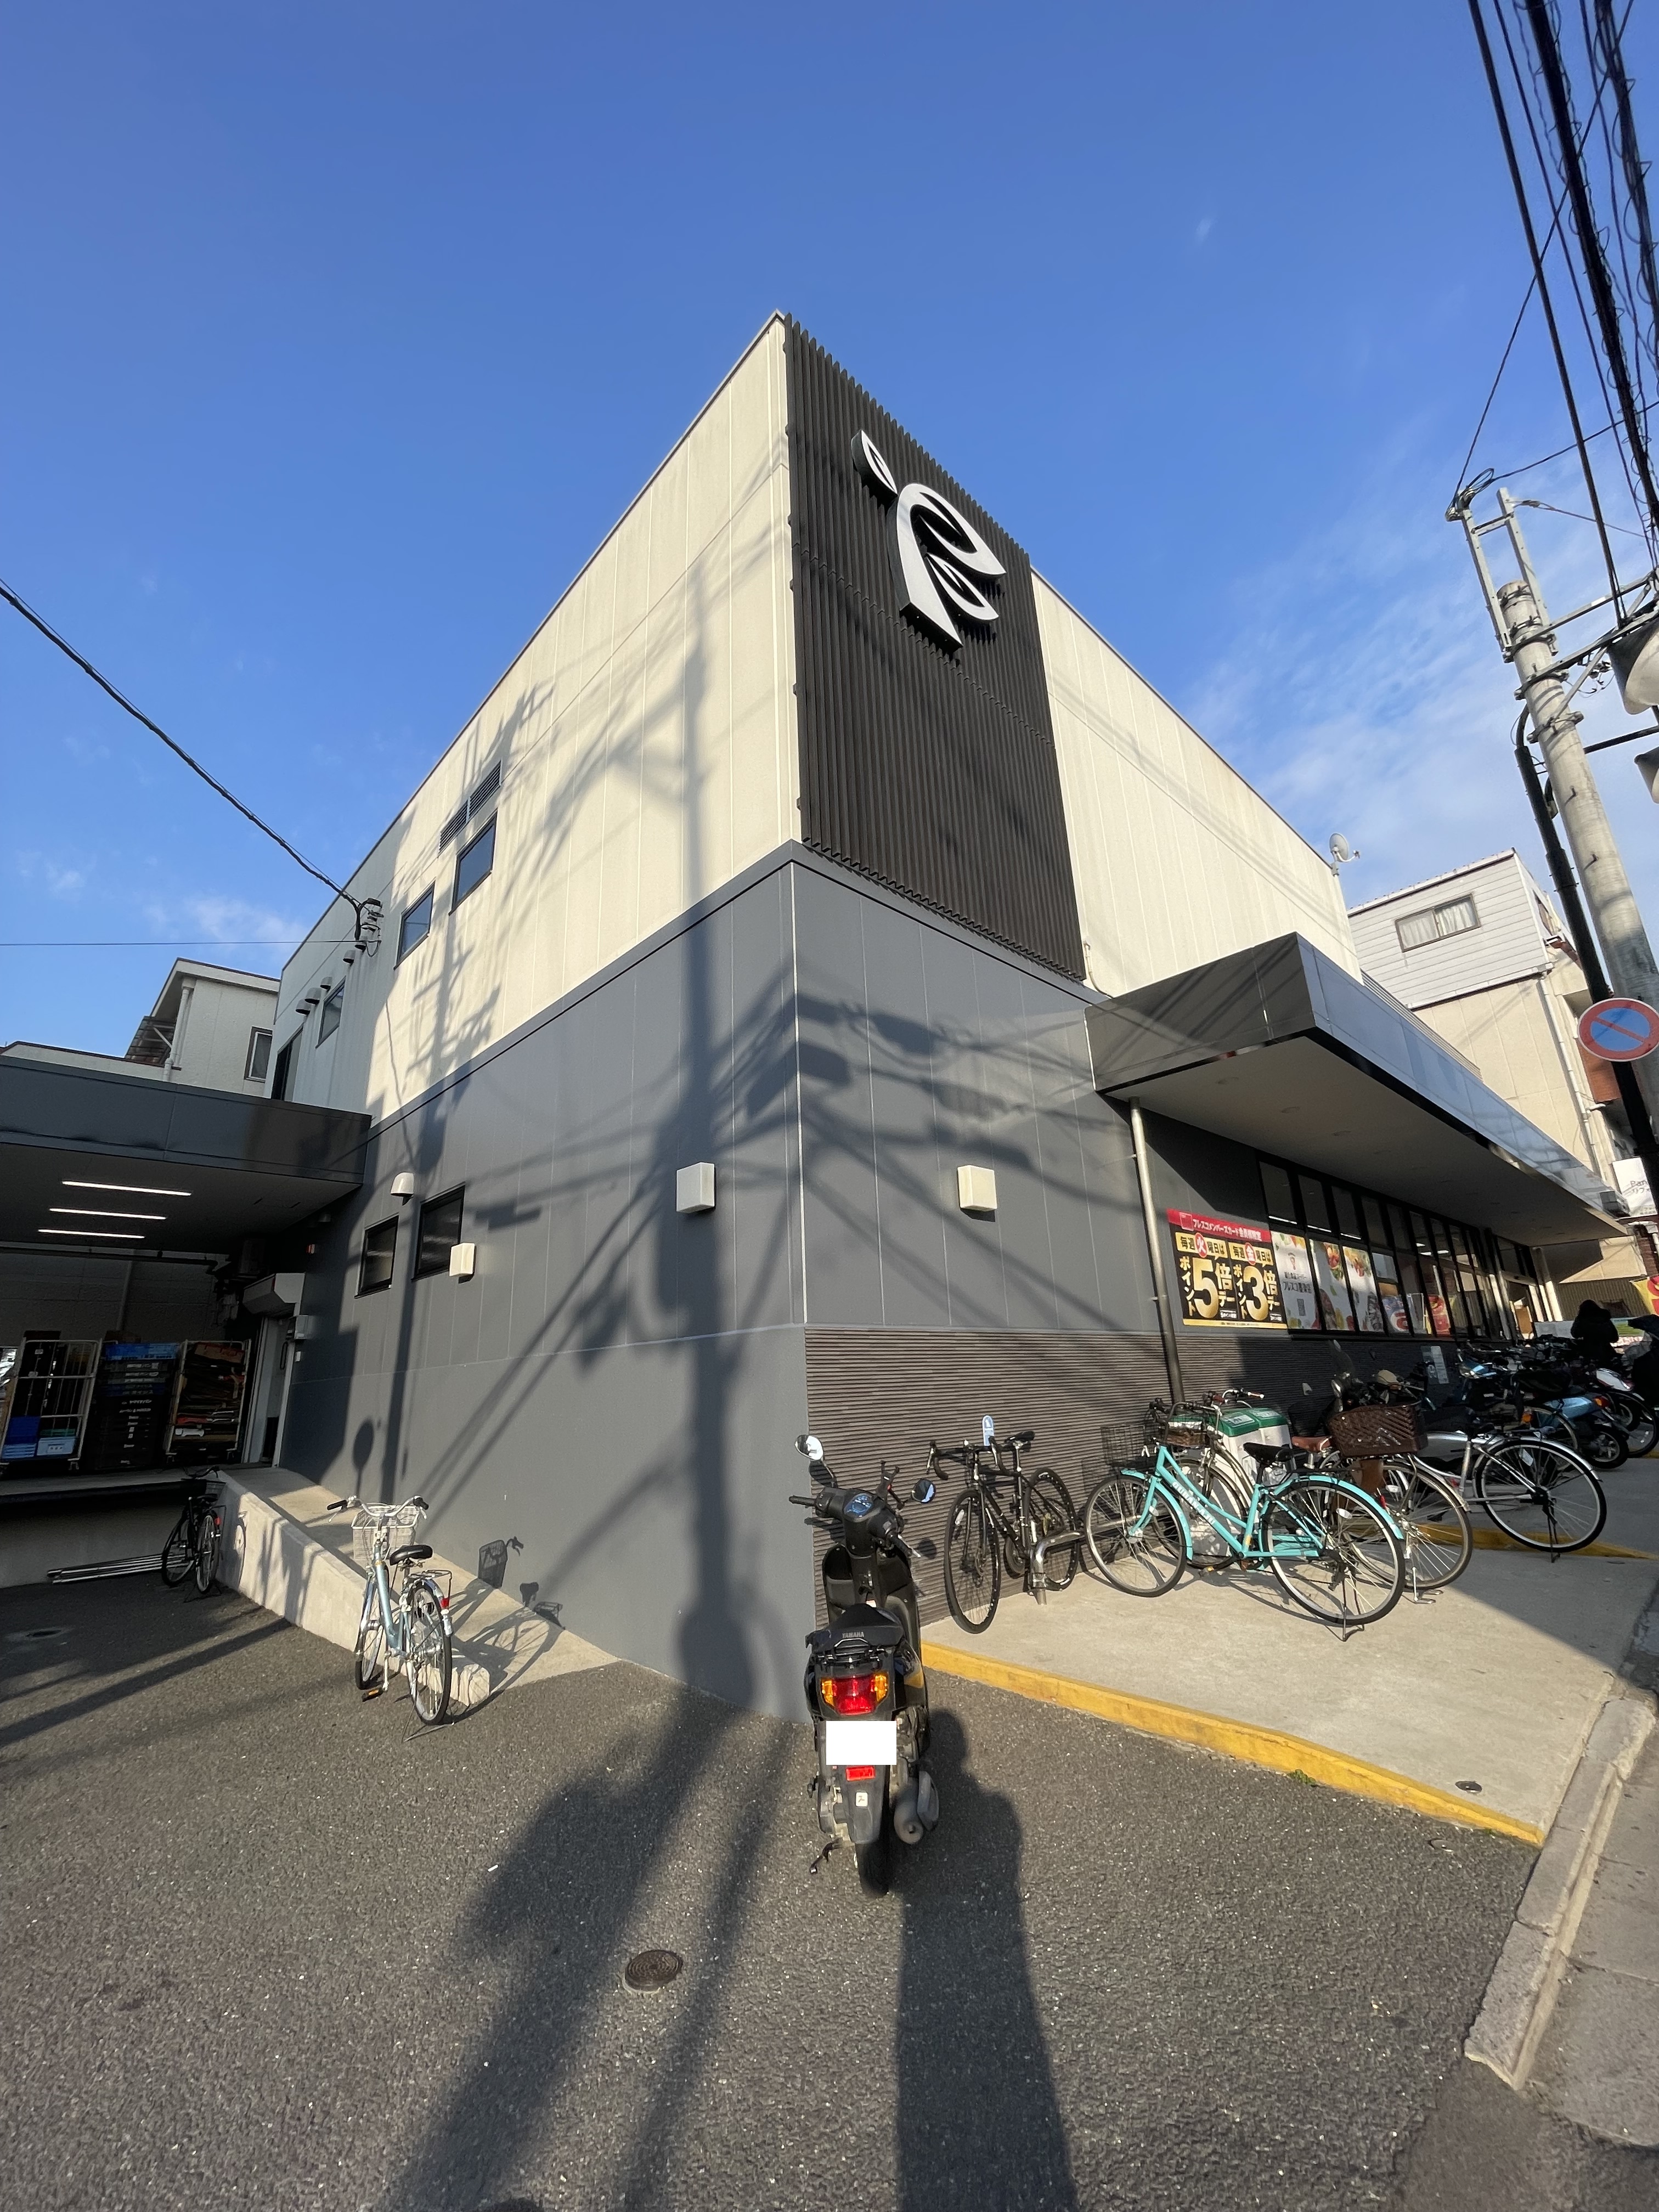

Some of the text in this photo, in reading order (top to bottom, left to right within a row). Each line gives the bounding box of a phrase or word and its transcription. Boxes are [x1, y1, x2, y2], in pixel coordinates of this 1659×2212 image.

[1181, 1234, 1225, 1255] 毎週火曜日は
[1233, 1243, 1272, 1263] 毎週金曜日は
[1180, 1256, 1196, 1316] ポイント
[1193, 1257, 1219, 1318] 5
[1233, 1263, 1248, 1319] ポイント
[1243, 1266, 1268, 1321] 3
[842, 1631, 865, 1639] YAMAHA
